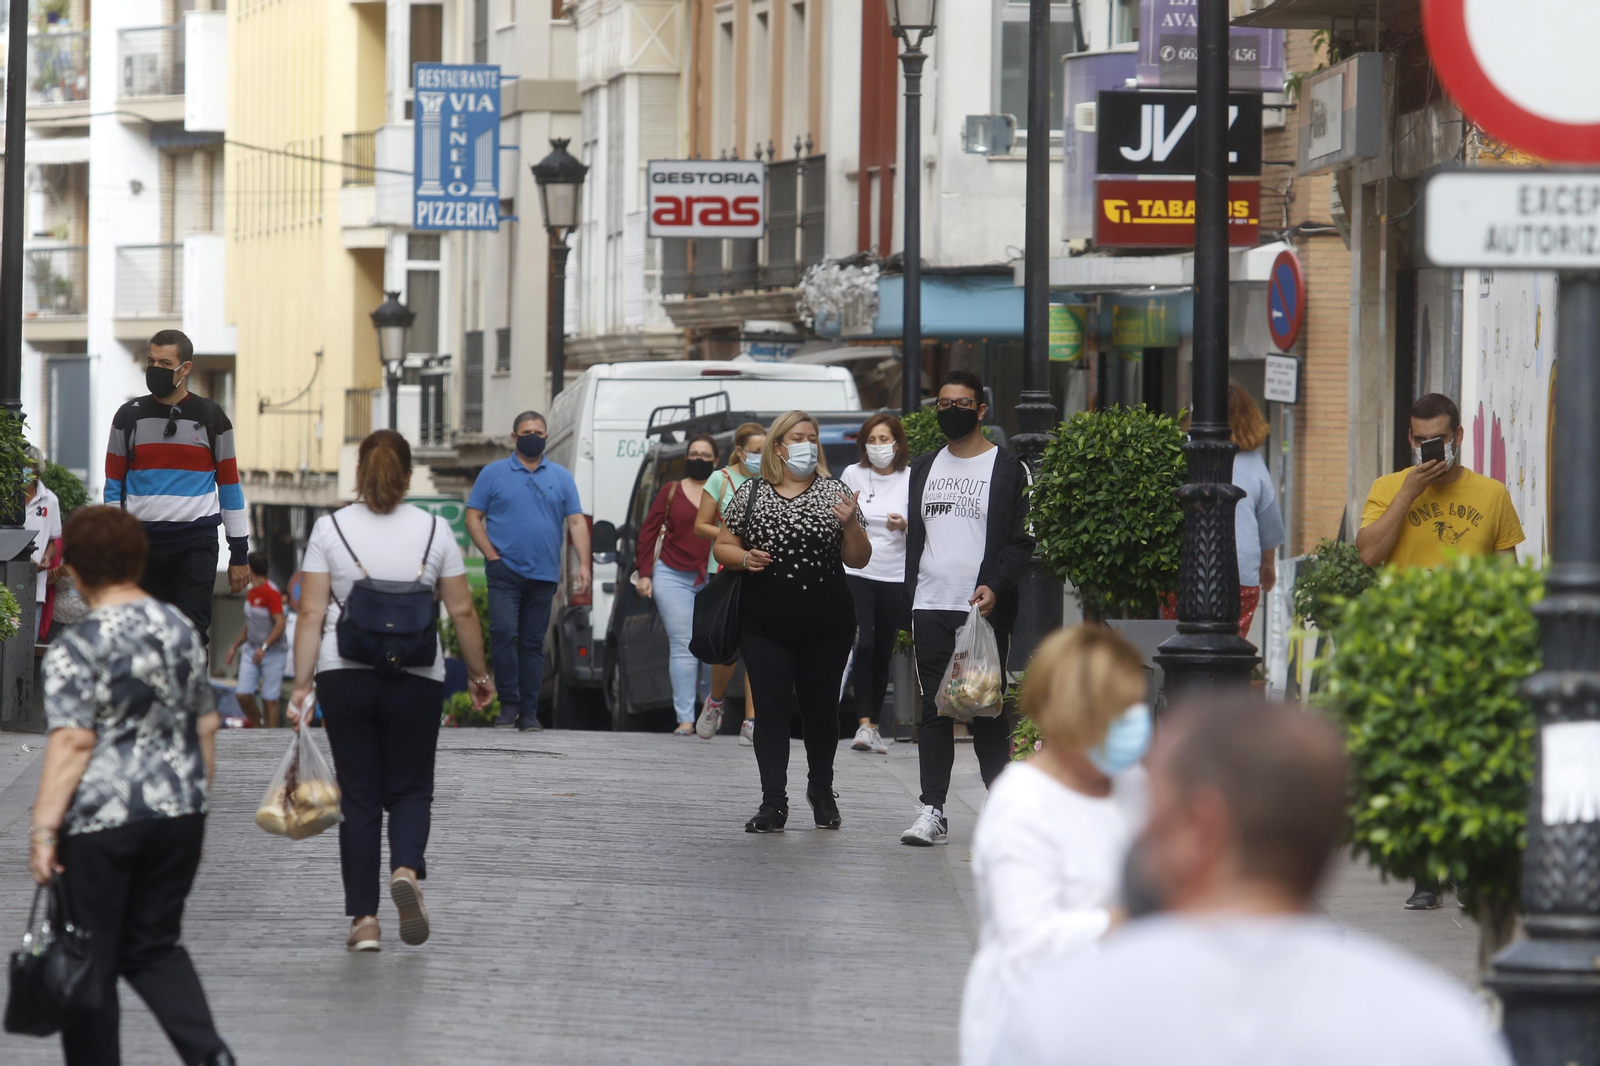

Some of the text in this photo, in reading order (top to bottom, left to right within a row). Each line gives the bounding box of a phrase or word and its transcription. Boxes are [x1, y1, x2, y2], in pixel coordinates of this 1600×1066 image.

[1161, 13, 1198, 27] AVA
[417, 68, 499, 90] RESTAURANTE
[449, 92, 495, 112] VIA
[1119, 104, 1239, 163] JV
[652, 172, 760, 184] GESTORIA
[416, 198, 498, 227] PIZZERÍA
[652, 195, 760, 226] aras
[1137, 199, 1250, 218] TABAS
[1484, 224, 1600, 254] AUTORIZ
[928, 478, 987, 497] WORKOUT
[943, 492, 957, 501] LIFE
[955, 496, 981, 509] ZONE
[954, 506, 981, 520] 00:05
[1408, 502, 1484, 528] ONE LOVE
